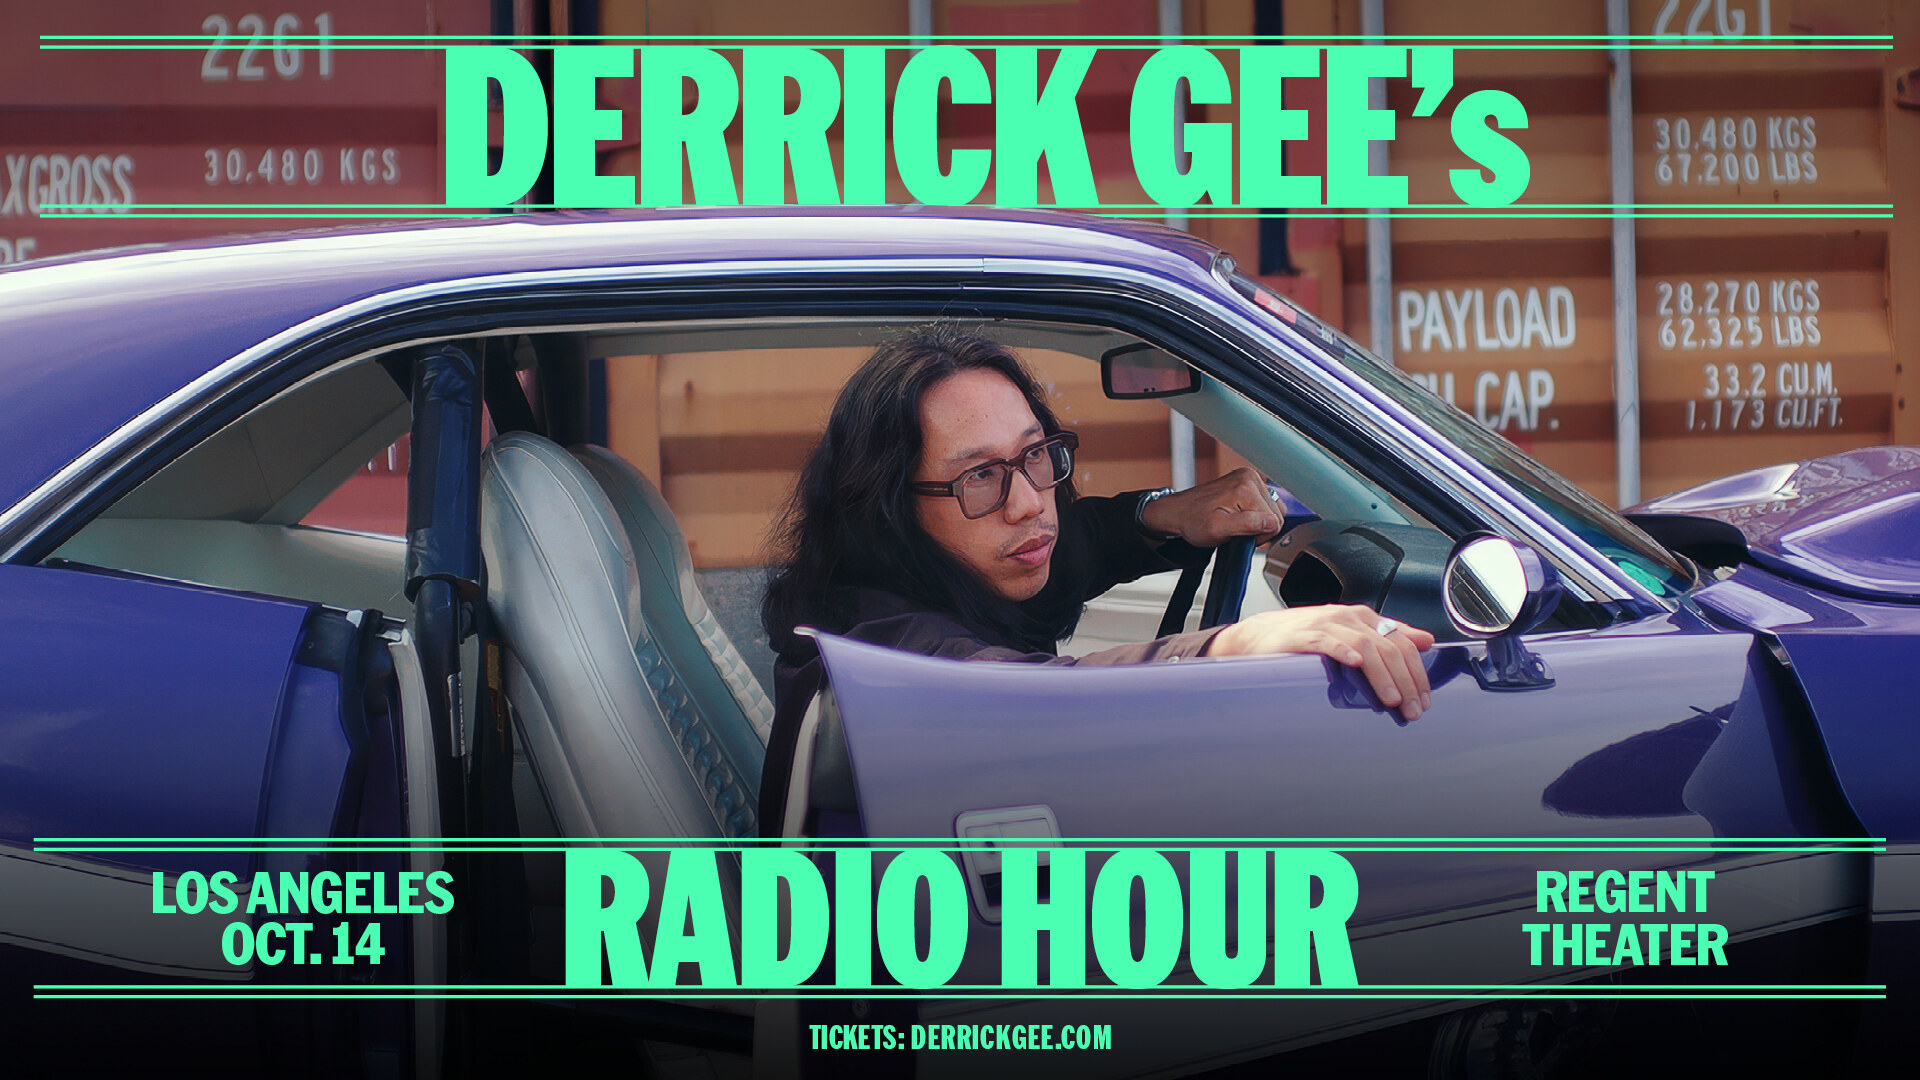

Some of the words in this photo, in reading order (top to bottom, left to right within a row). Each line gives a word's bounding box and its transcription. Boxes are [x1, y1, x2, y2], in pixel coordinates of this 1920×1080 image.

[201, 12, 334, 80] 22G1
[1766, 115, 1817, 150] KGS
[0, 153, 135, 215] XGROSS
[204, 148, 322, 185] 30,480
[339, 148, 398, 185] KGS
[1767, 150, 1818, 184] LBS
[1657, 280, 1760, 318] 28,270
[1770, 278, 1820, 315] KGS
[1398, 285, 1577, 351] PAYLOAD
[1658, 316, 1763, 350] 62,325
[1771, 315, 1821, 348] LBS
[1703, 362, 1767, 399] 33.2
[1776, 360, 1838, 397] CU.M.
[1474, 368, 1560, 431] CAP.
